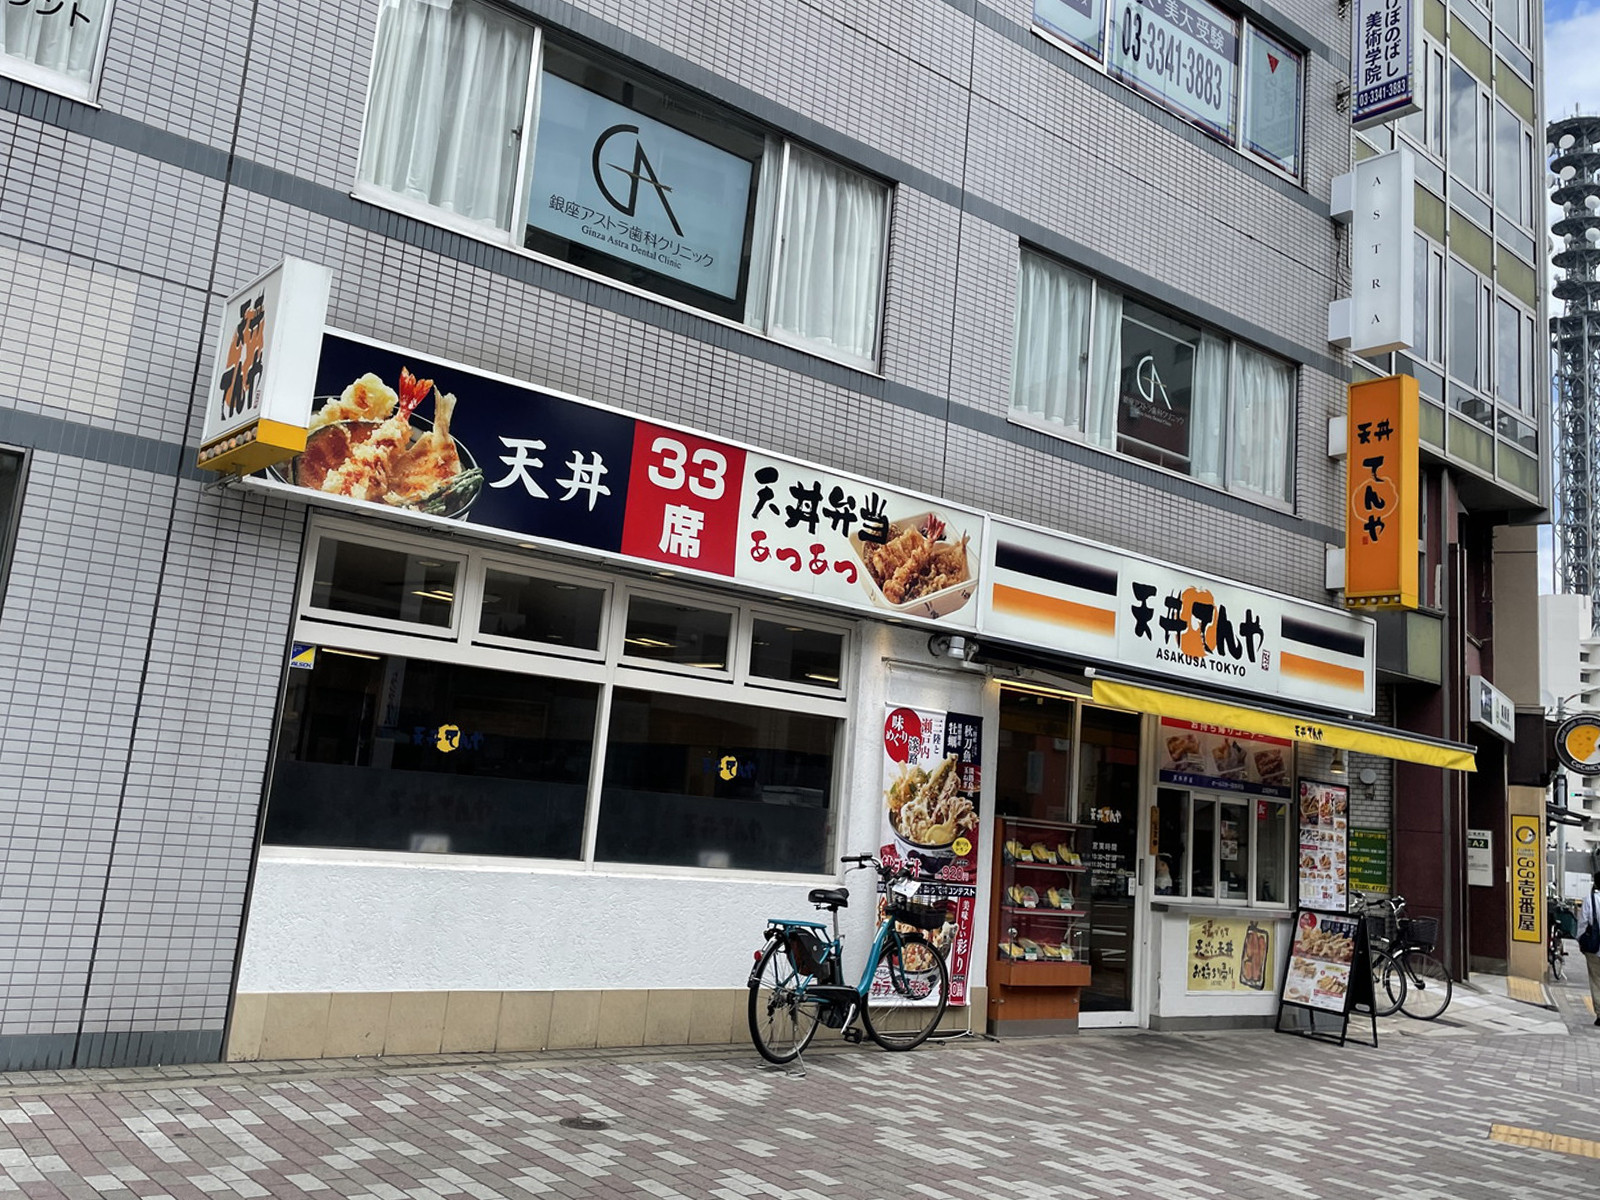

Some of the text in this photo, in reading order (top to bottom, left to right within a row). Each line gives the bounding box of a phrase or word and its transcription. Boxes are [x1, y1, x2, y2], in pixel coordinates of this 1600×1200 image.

[1121, 6, 1223, 111] 03-3341-3883
[1364, 11, 1383, 87] 美術学院
[549, 194, 714, 268] 銀座アストラ歯科クリニック
[581, 224, 682, 269] Ginza Astra Dental Clinic
[1371, 176, 1382, 325] ASTRA
[1357, 418, 1394, 445] 天丼
[489, 435, 612, 512] 天丼
[647, 436, 728, 500] 33
[1362, 455, 1386, 542] てんや
[658, 503, 706, 559] 席
[752, 466, 889, 545] 天丼弁当
[750, 530, 858, 585] あつあつ
[1156, 647, 1207, 669] ASAKUSA
[1209, 659, 1246, 678] TOKYO
[885, 729, 908, 747] めぐり
[1472, 839, 1485, 848] A2
[956, 900, 970, 973] 美味しい彩り
